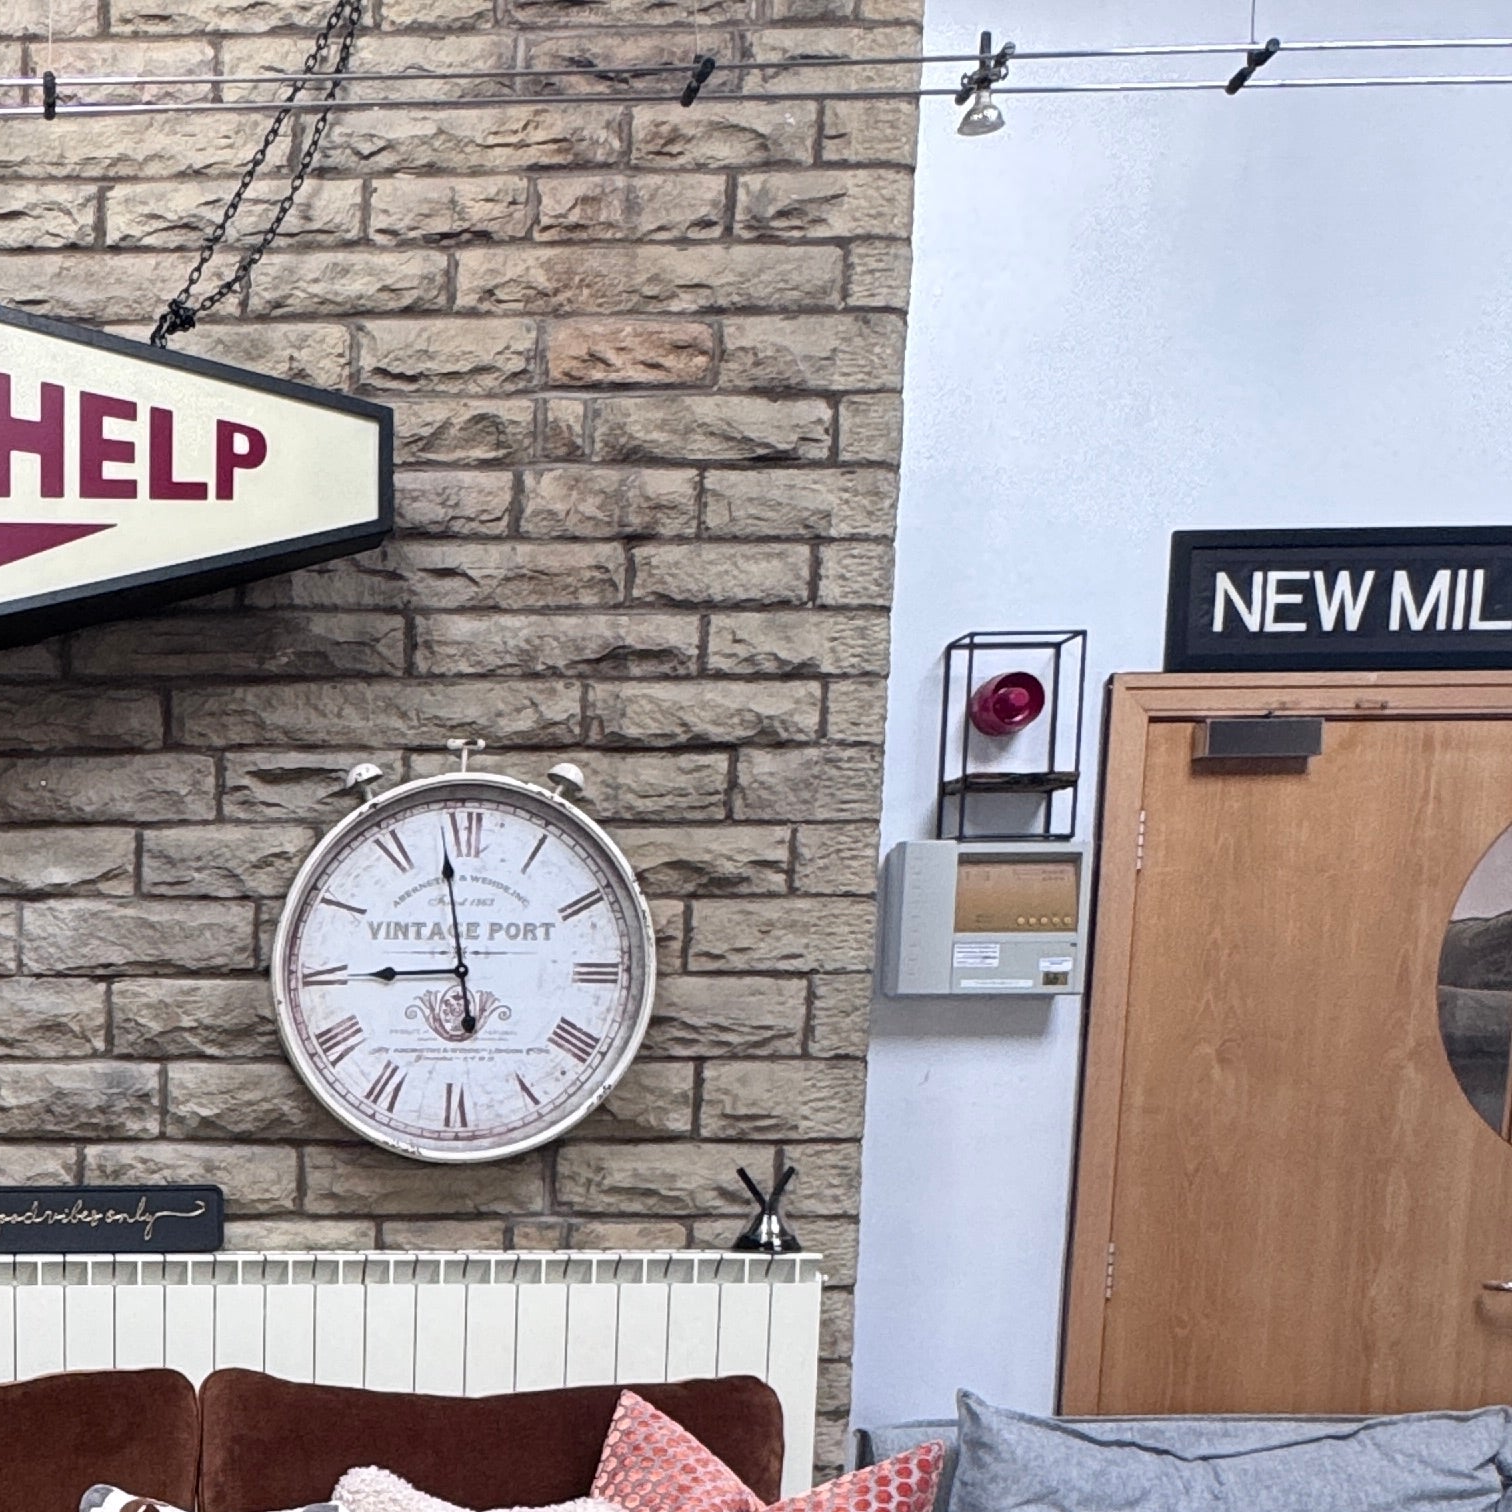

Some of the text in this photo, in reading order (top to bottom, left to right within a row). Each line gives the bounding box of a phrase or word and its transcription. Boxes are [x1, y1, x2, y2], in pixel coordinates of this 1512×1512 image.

[1212, 569, 1512, 632] NEW MIL
[367, 920, 556, 942] VINTAGE PORT
[42, 1200, 100, 1228] vibes
